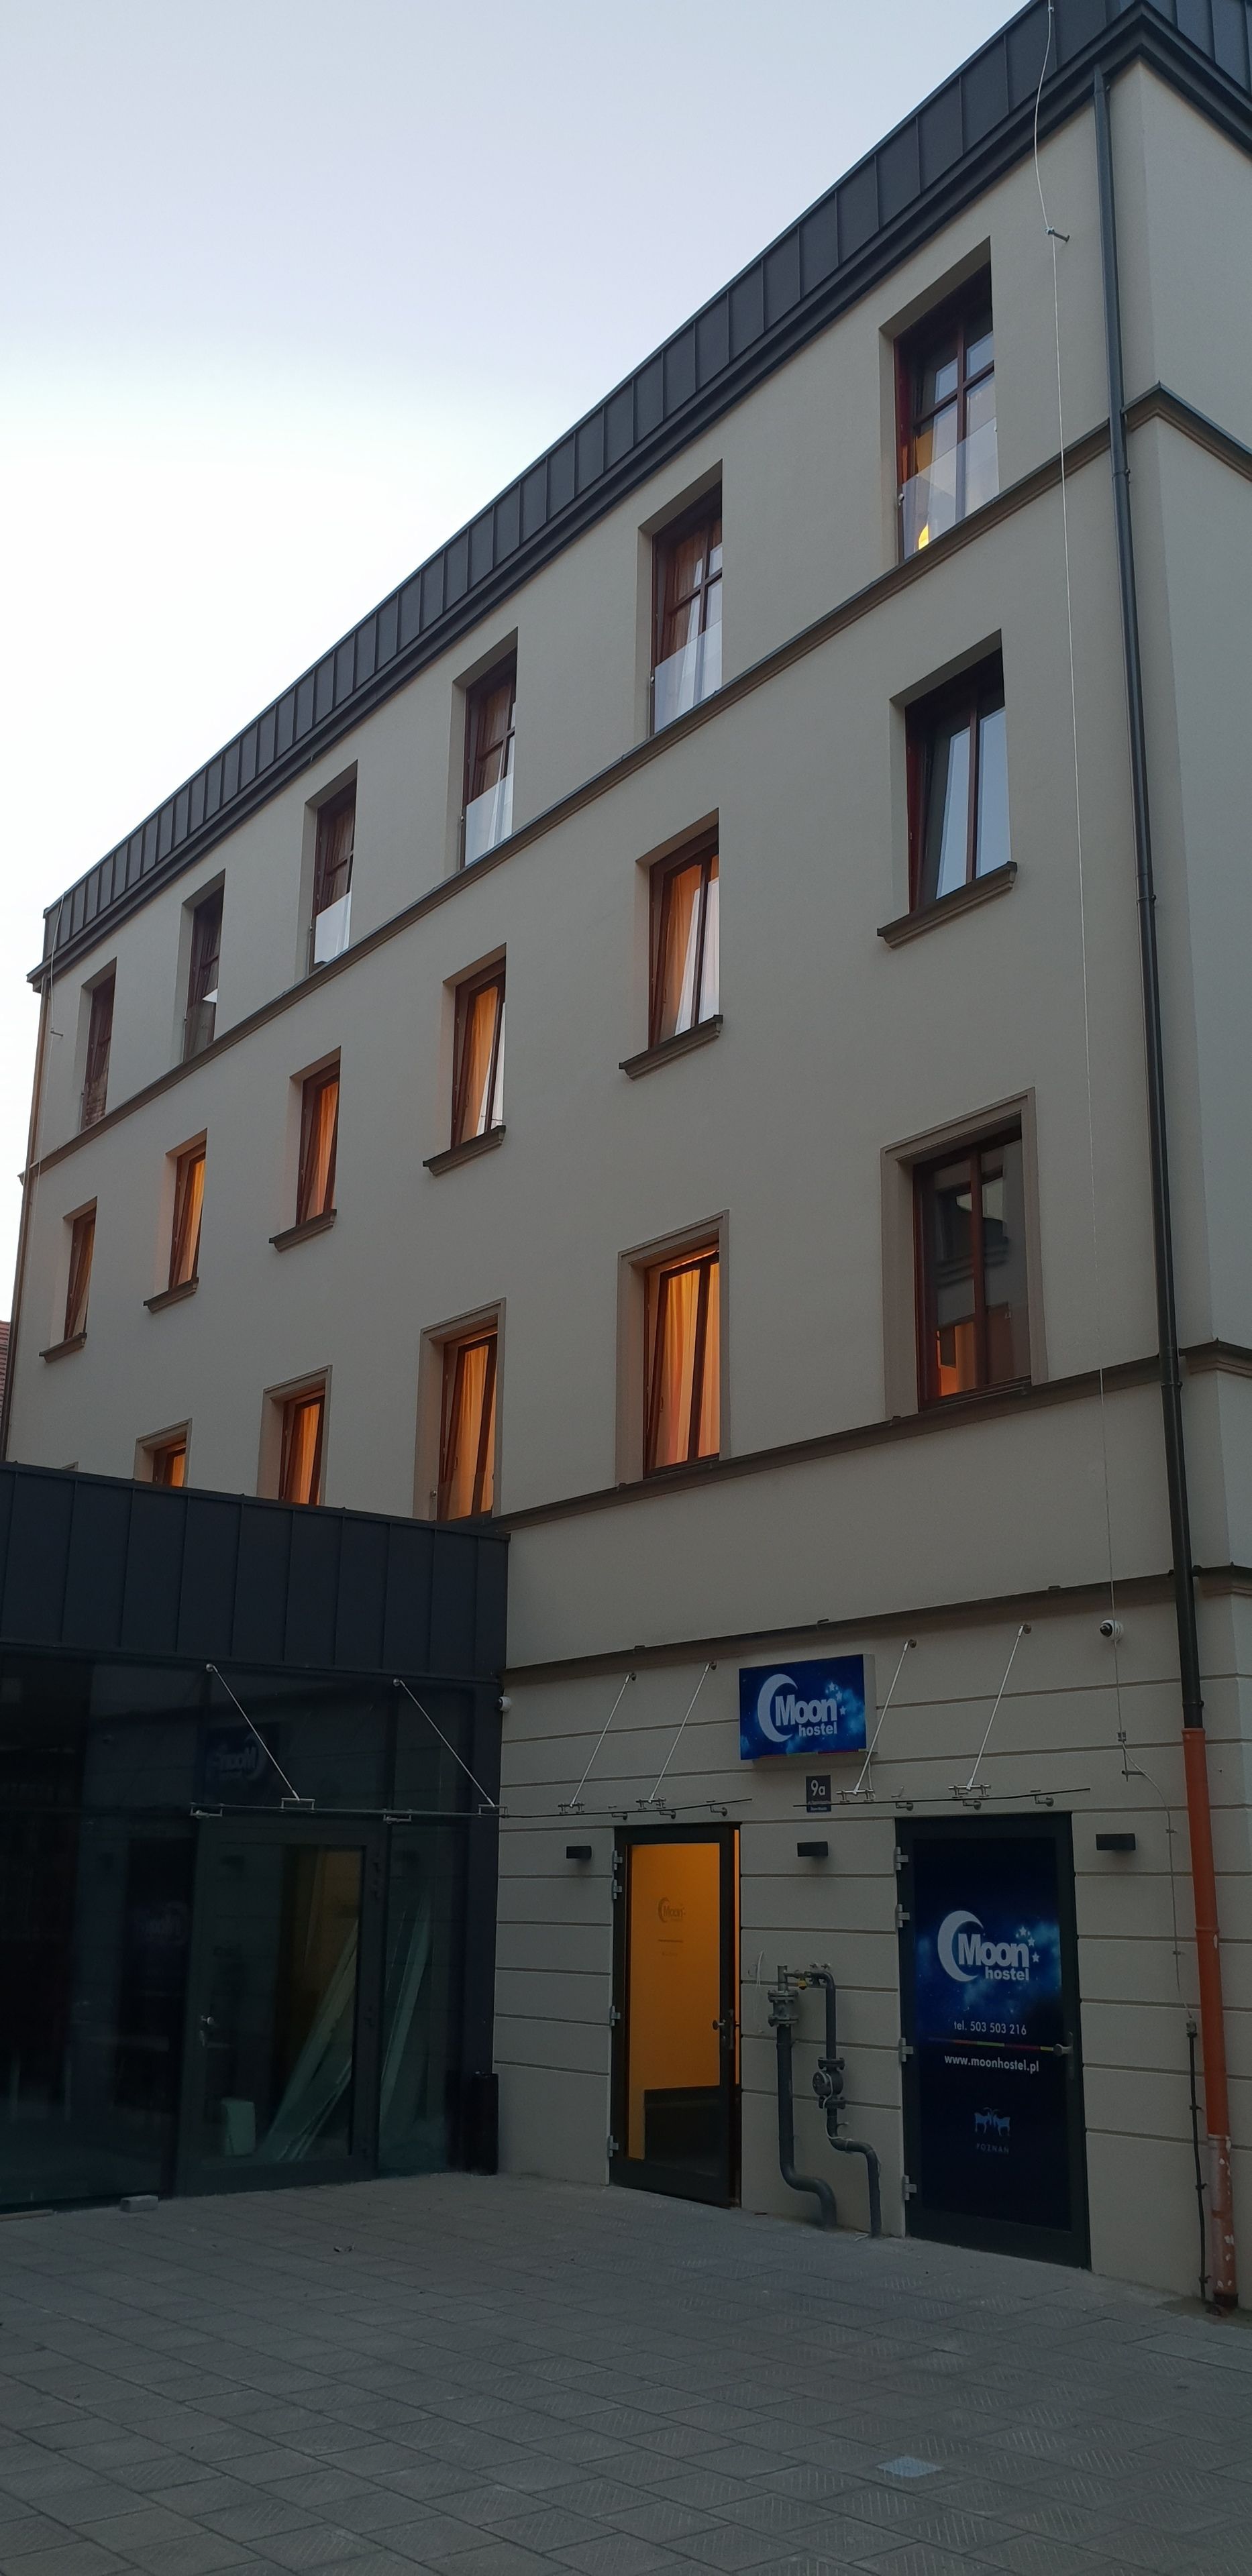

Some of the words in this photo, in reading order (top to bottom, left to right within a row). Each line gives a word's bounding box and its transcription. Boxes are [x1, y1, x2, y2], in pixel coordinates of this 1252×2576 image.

[776, 1695, 837, 1726] Moon
[798, 1721, 837, 1737] hostel
[811, 1780, 826, 1796] 9a
[958, 1933, 1030, 1968] Moon
[985, 1966, 1030, 1981] hostel
[954, 2020, 967, 2030] tel.
[970, 2021, 987, 2032] 503
[990, 2023, 1006, 2034] 503
[1009, 2024, 1027, 2035] 216
[944, 2055, 1039, 2074] www.moonhostel.pl
